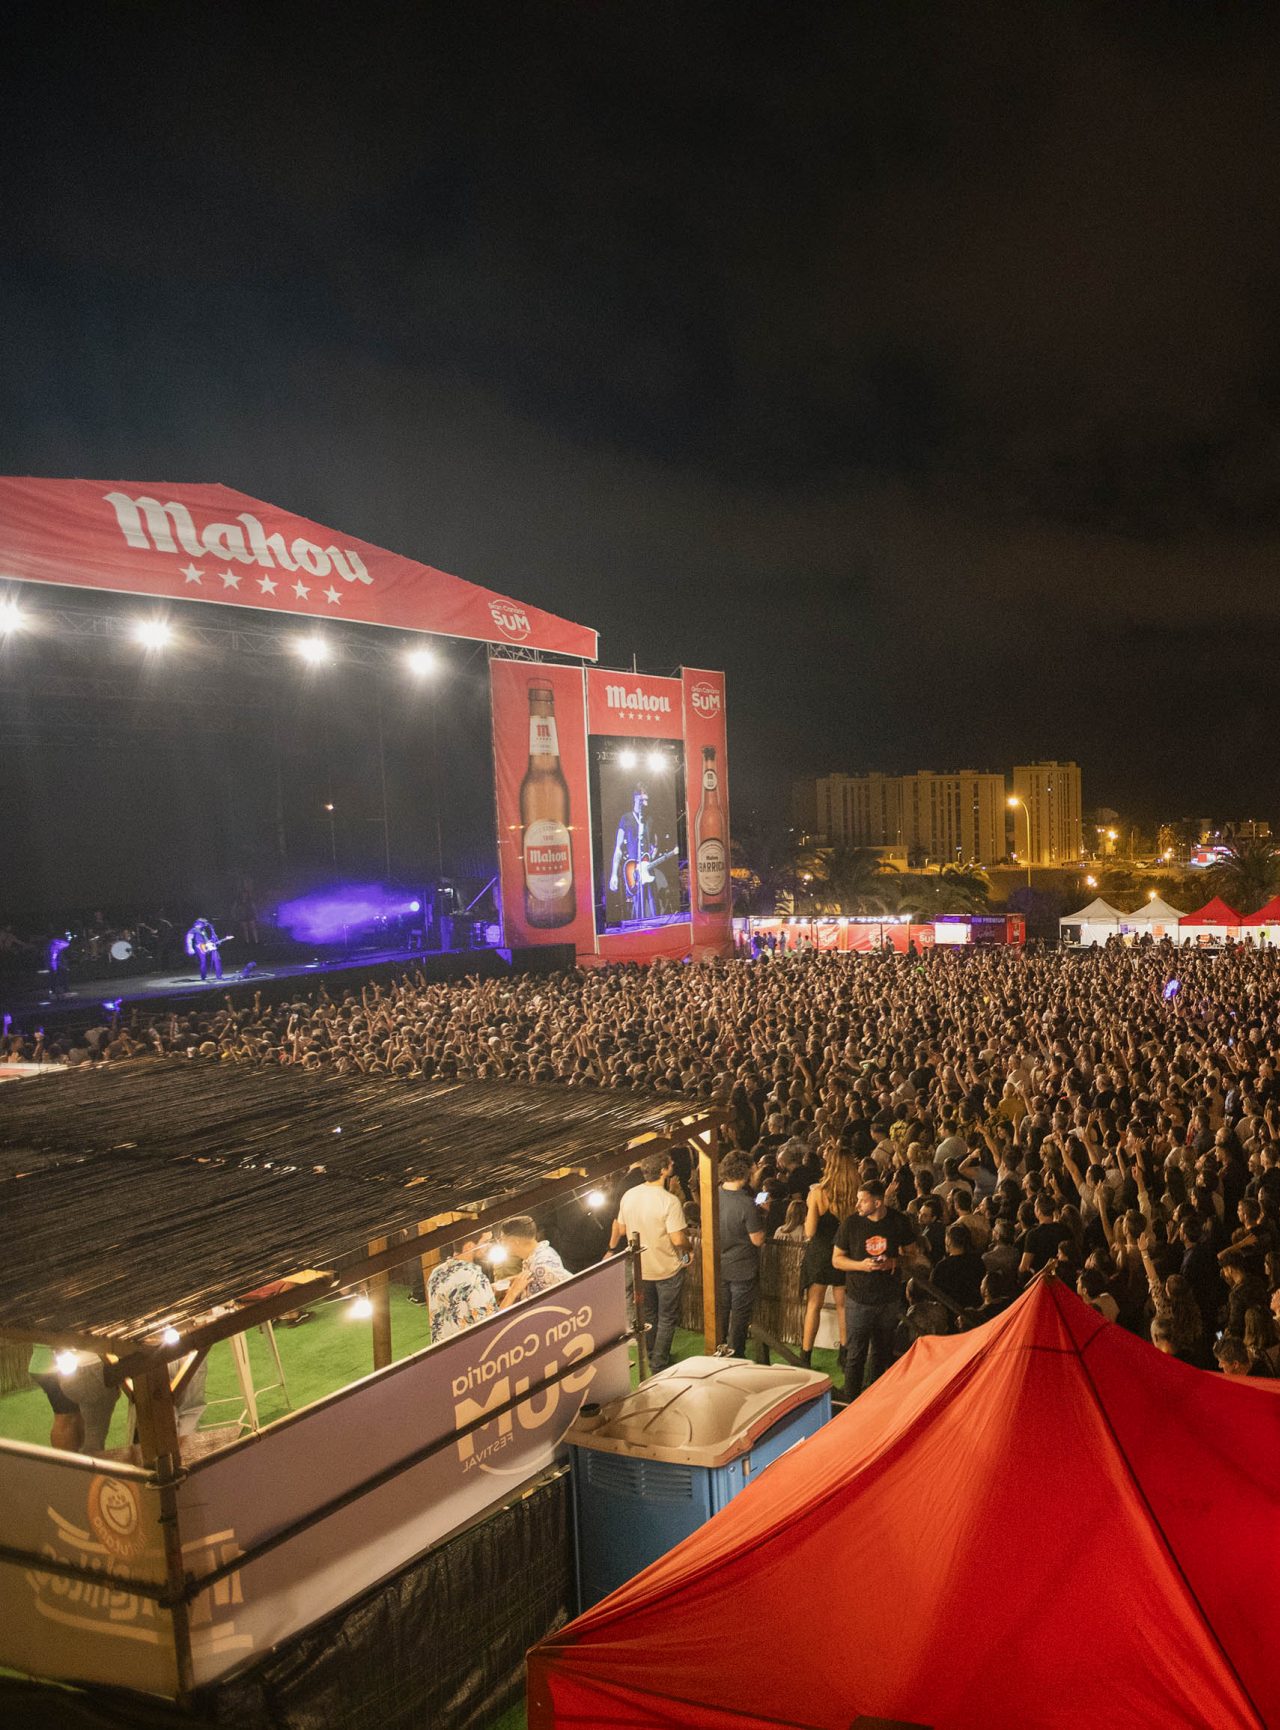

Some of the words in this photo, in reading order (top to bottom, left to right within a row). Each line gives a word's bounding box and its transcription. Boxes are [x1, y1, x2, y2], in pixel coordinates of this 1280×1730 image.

[102, 492, 374, 585] Mahou
[491, 609, 531, 634] SUM
[605, 685, 672, 712] Mahou
[692, 692, 720, 710] SUM
[530, 849, 567, 864] Mahou
